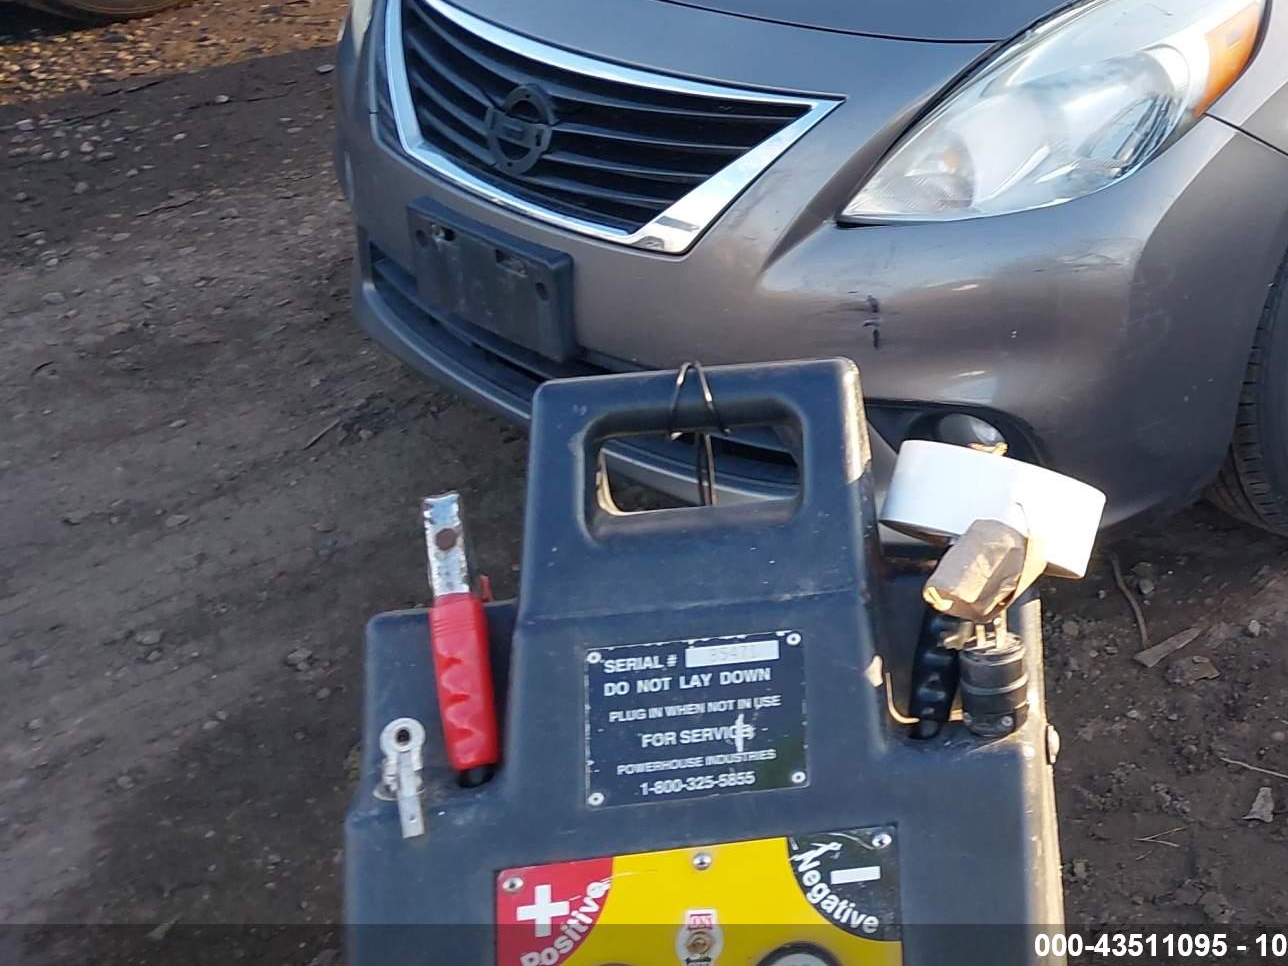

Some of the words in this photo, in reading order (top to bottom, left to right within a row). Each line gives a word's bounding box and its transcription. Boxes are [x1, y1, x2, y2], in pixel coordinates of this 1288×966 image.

[603, 656, 664, 673] SERIAL
[603, 681, 630, 697] DO
[636, 677, 672, 694] NOT
[679, 673, 712, 690] LAY
[719, 667, 772, 686] DOWN
[609, 710, 647, 723] PLUG
[648, 708, 663, 719] IN
[665, 705, 706, 718] WHEN
[707, 700, 736, 713] NOT
[738, 697, 751, 710] IN
[753, 694, 782, 709] USE
[641, 732, 677, 748] FOR
[616, 756, 704, 775] POWERHOUSE
[705, 749, 777, 766] INDUSTRIES
[793, 849, 880, 934] Negative
[520, 881, 607, 966] Positive
